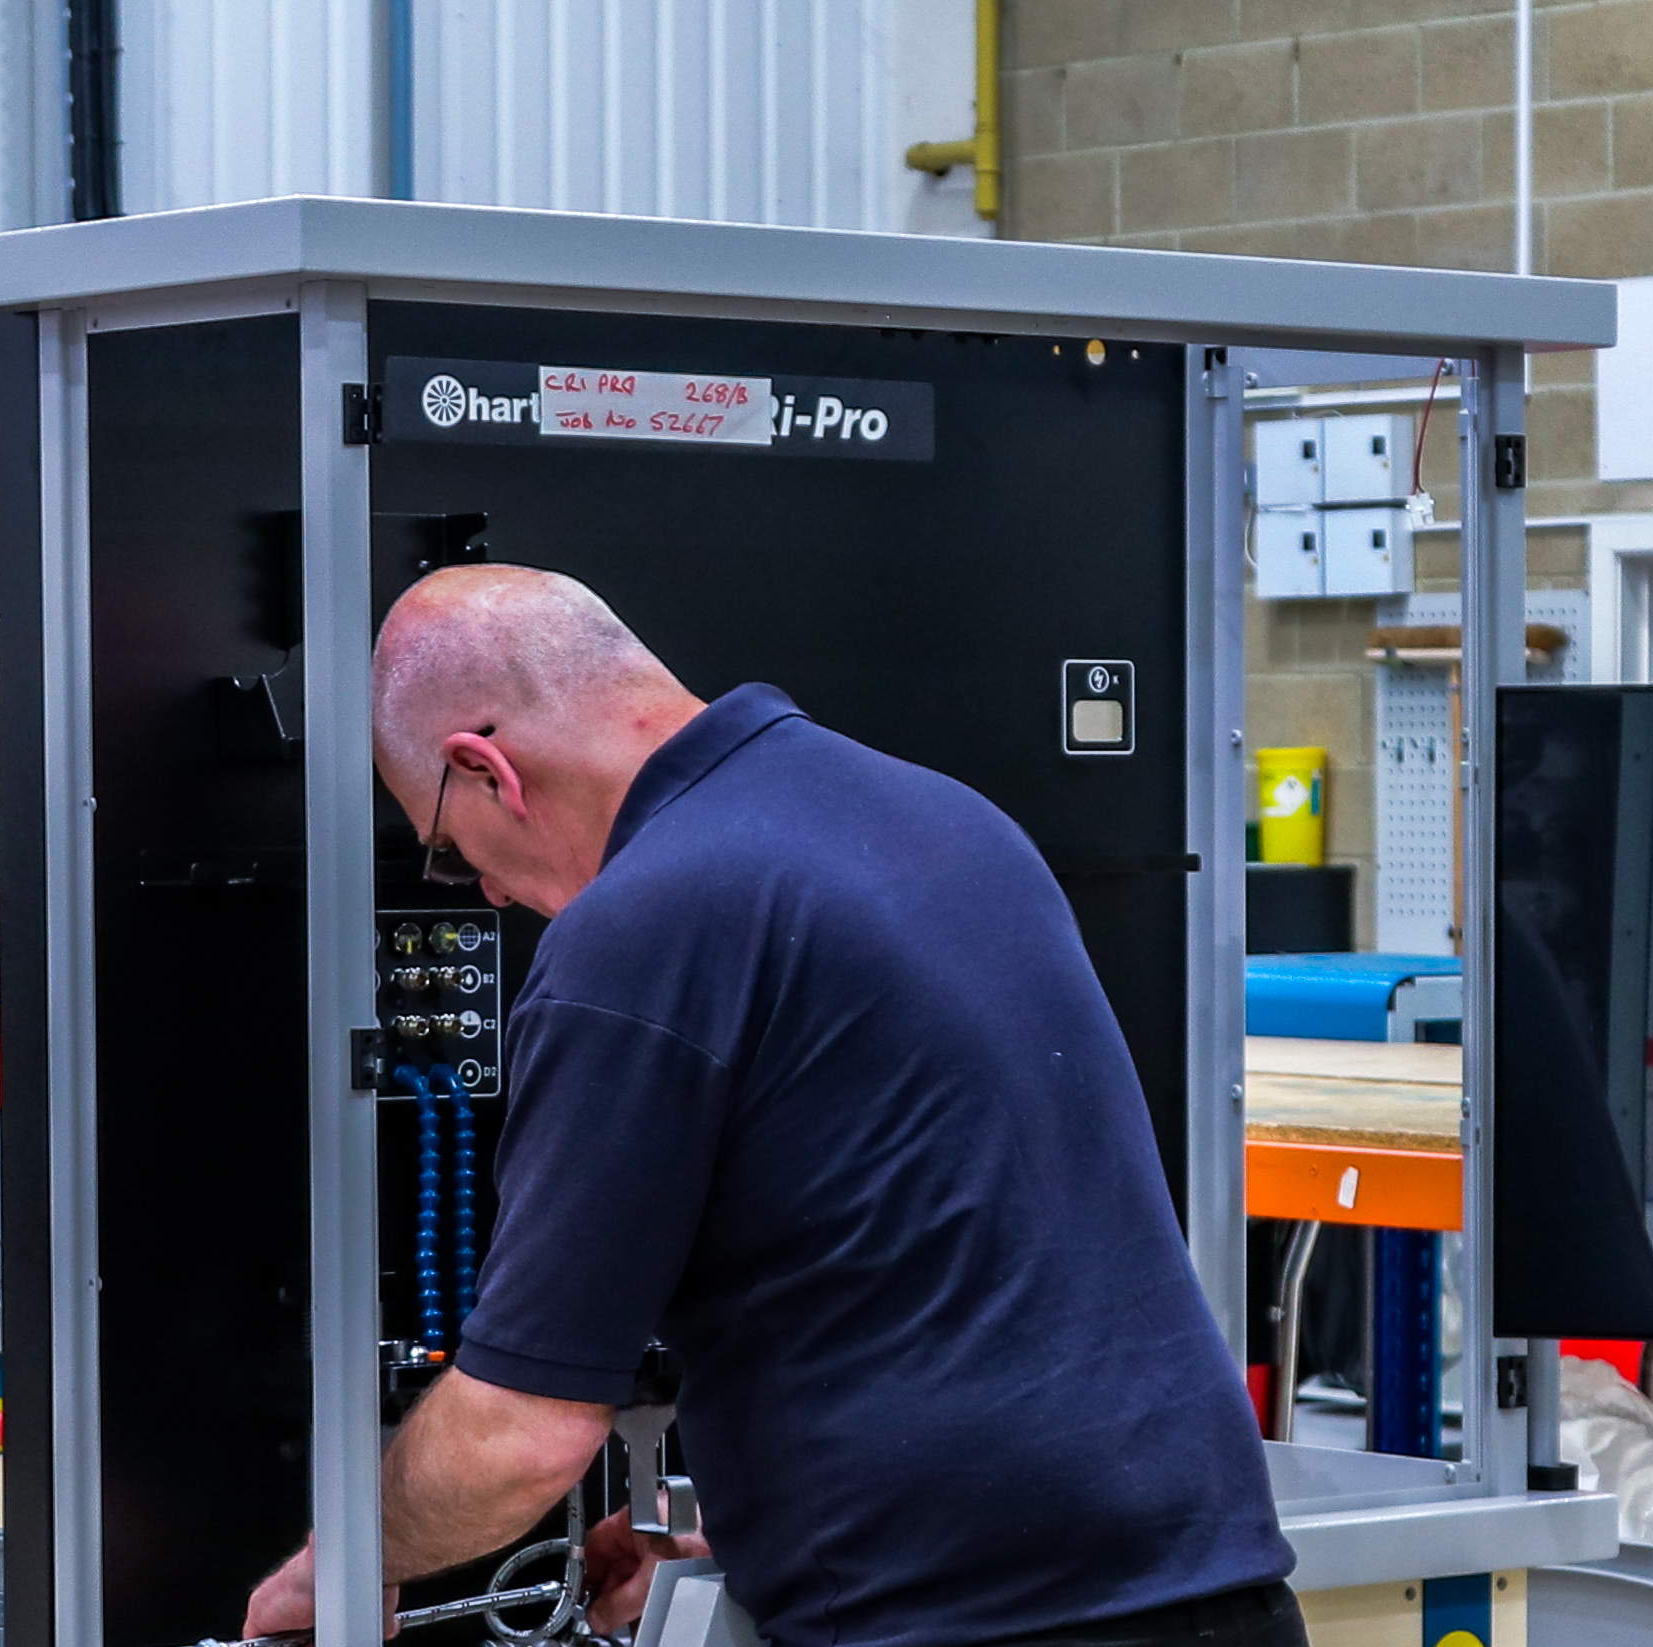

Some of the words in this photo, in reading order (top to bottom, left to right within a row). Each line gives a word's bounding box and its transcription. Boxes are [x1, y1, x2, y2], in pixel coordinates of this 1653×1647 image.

[597, 374, 636, 396] PRO
[685, 382, 749, 409] 268/B
[468, 386, 542, 424] hart
[605, 409, 637, 430] No
[649, 411, 725, 436] 52667
[482, 931, 496, 942] A2
[483, 1018, 497, 1030] C2
[483, 1066, 497, 1077] D2
